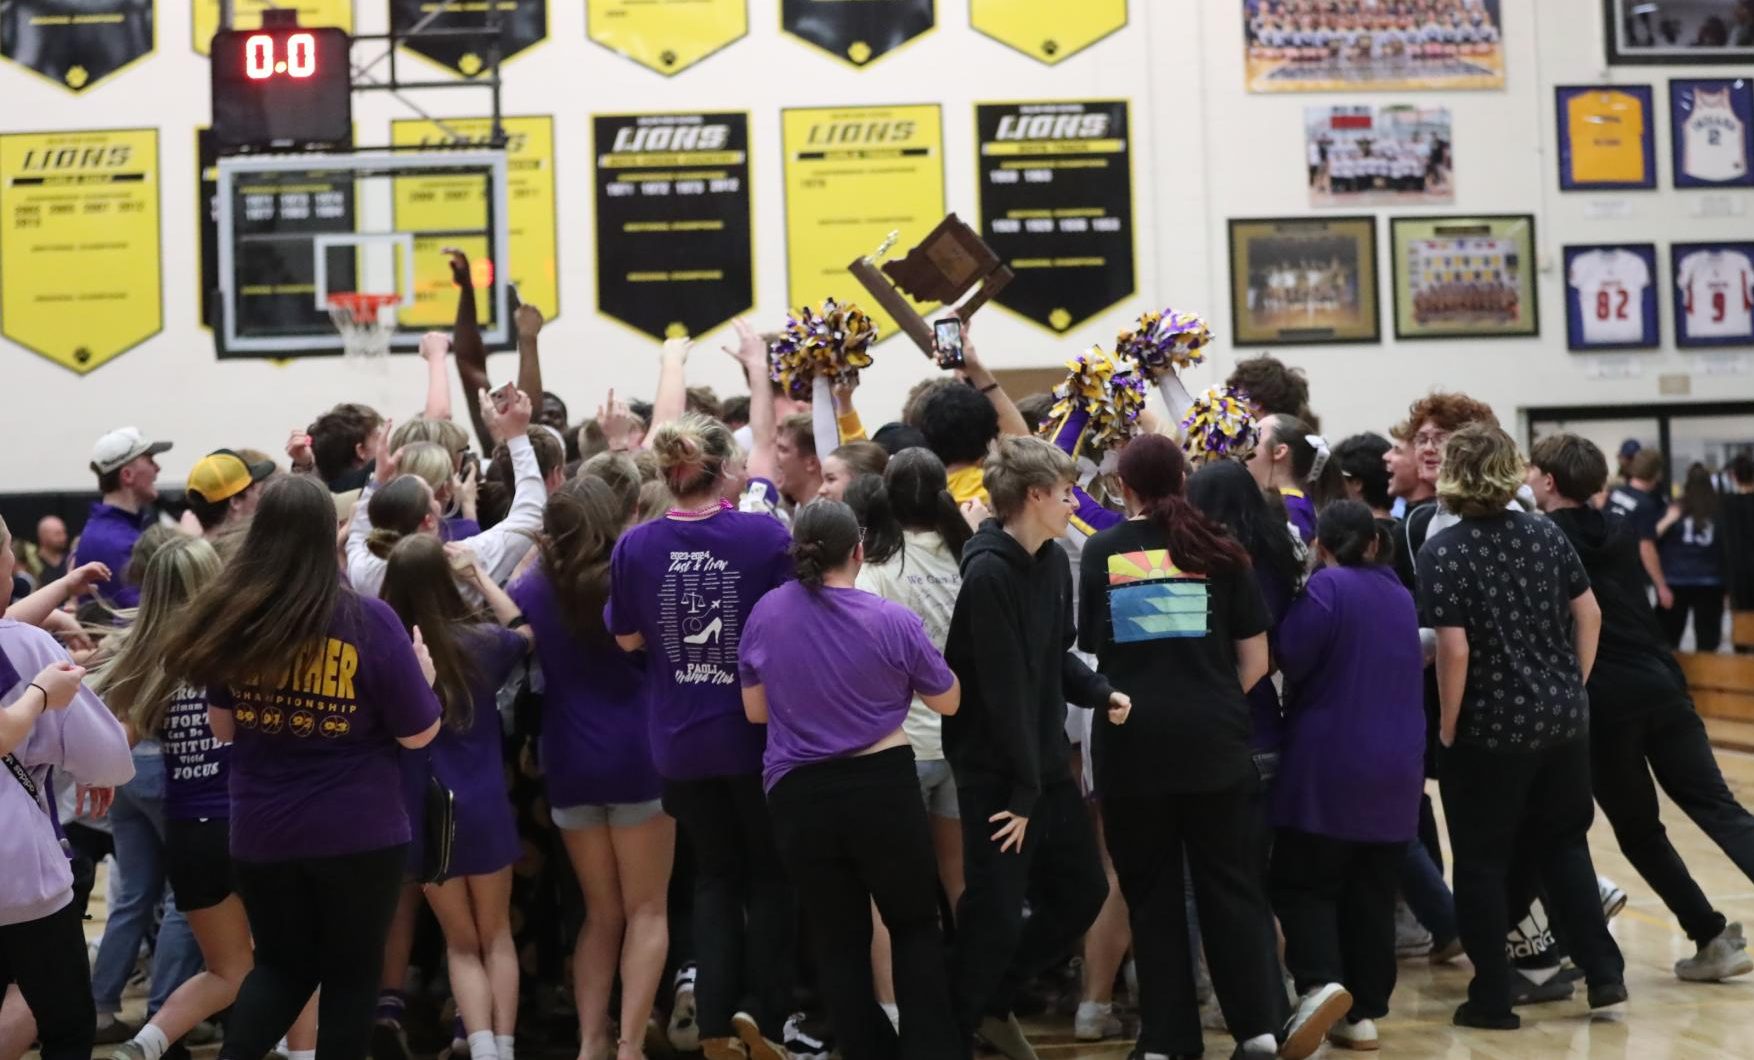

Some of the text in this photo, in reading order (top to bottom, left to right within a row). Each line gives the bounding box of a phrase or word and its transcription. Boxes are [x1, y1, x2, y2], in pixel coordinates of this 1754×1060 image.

[246, 34, 315, 78] 0.0
[808, 122, 915, 144] LIONS
[995, 113, 1109, 140] LIONS
[613, 124, 730, 152] LIONS
[23, 147, 131, 170] LIONS
[1595, 288, 1629, 321] 82
[1711, 291, 1727, 323] 9
[668, 559, 692, 573] Cast
[703, 557, 729, 571] Crew
[669, 550, 711, 560] 2023-2024
[675, 669, 735, 685] Drama Club
[686, 663, 718, 675] PAOLI
[163, 712, 210, 729] FFORT
[189, 728, 204, 737] Do
[13, 764, 35, 792] adidas
[173, 761, 219, 780] FOCUS
